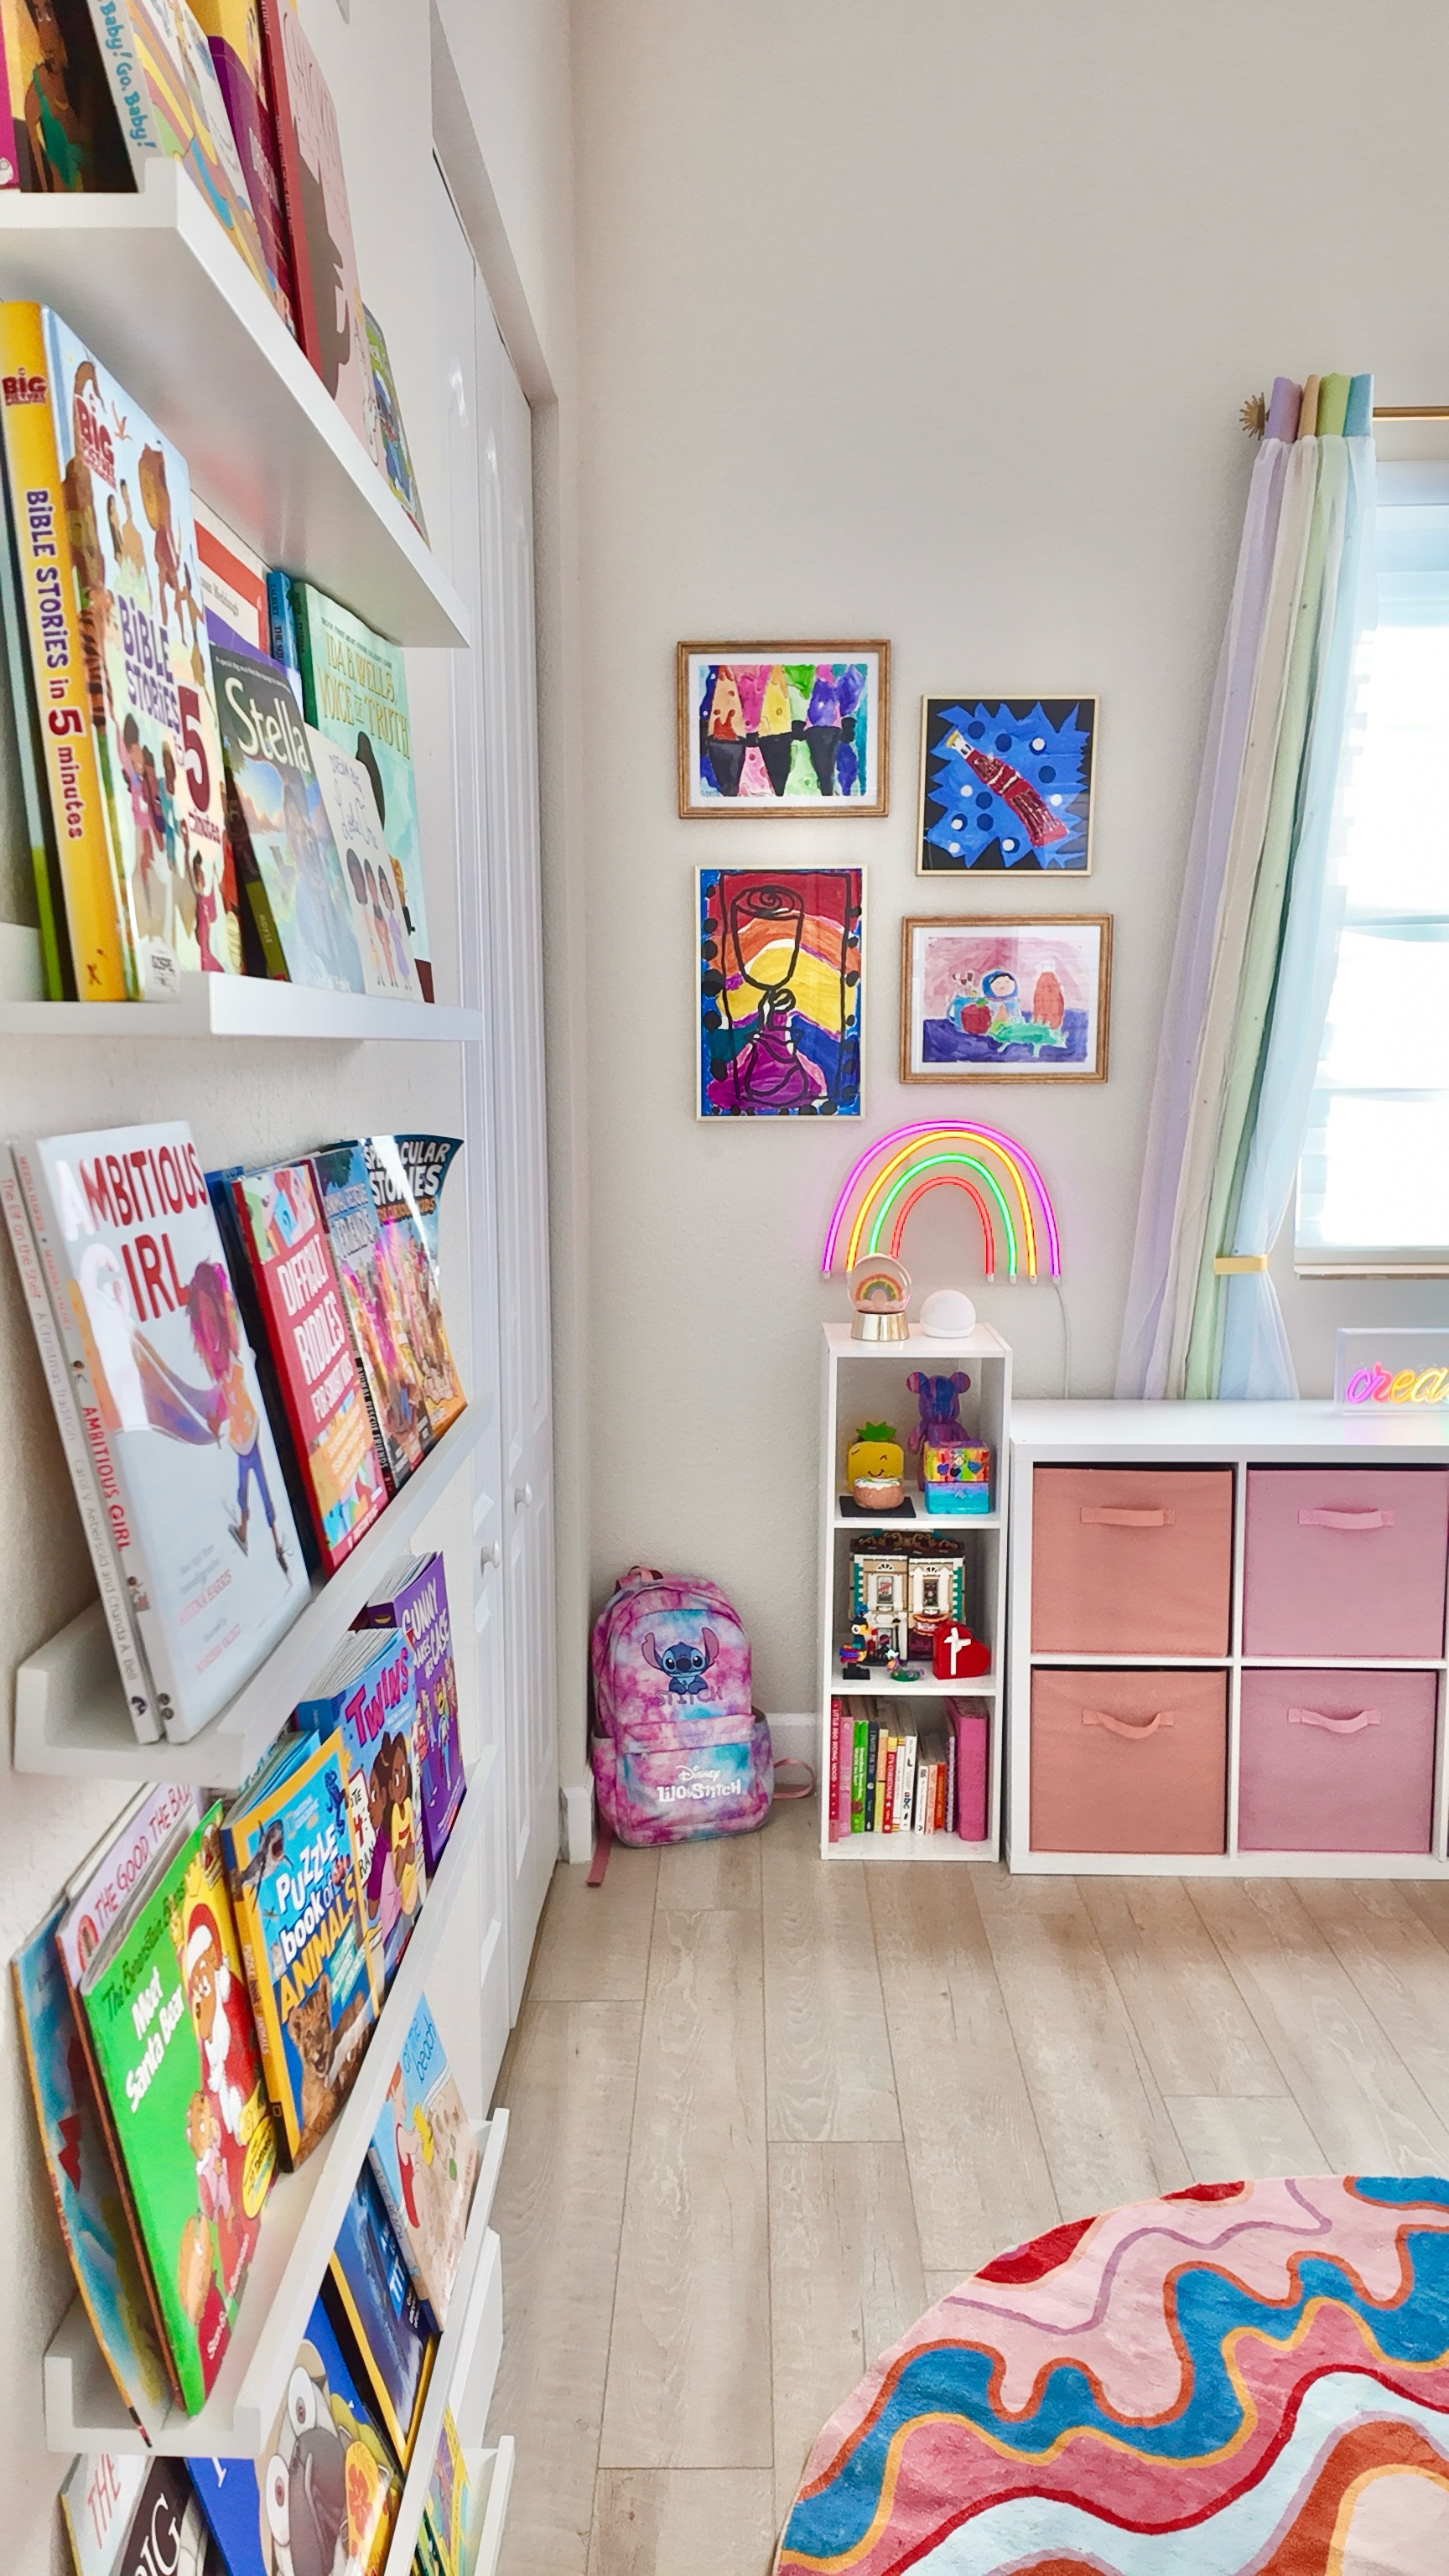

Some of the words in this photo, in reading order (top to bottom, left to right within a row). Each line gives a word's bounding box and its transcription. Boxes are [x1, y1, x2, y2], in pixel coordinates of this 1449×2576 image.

[100, 1, 133, 59] Baby!
[124, 91, 158, 148] Baby!
[275, 626, 283, 641] THE
[325, 631, 345, 676] IDA
[49, 678, 69, 699] in
[316, 663, 356, 726] VOICE
[364, 695, 411, 760] TRUTH
[48, 709, 83, 736] 5
[178, 684, 210, 813] 5
[224, 676, 312, 774] Stella
[58, 745, 85, 839] minutes
[363, 1140, 451, 1170] SPCULAR
[1, 1178, 15, 1202] The
[8, 1204, 22, 1219] Elf
[55, 1142, 208, 1242] AMBITIOUS
[14, 1224, 25, 1241] on
[19, 1244, 31, 1265] the
[25, 1270, 41, 1299] Shelf
[80, 1233, 191, 1322] GIRL
[276, 1233, 330, 1317] DIFFICULT
[40, 1324, 61, 1385] Christmas
[293, 1290, 345, 1386] RIDDLES
[1345, 1360, 1449, 1405] crea
[56, 1389, 76, 1441] Tradition
[356, 1367, 370, 1397] ANIMAL
[364, 1400, 379, 1433] RESCUE
[372, 1434, 389, 1468] FRIENDS
[74, 1459, 91, 1491] Carol
[82, 1406, 121, 1499] AMBITIOUS
[109, 1504, 132, 1552] GIRL
[86, 1507, 109, 1567] Aebersold
[101, 1571, 116, 1593] and
[108, 1595, 127, 1641] Chanda
[429, 1608, 450, 1666] CASE
[122, 1659, 138, 1681] Bell
[674, 1765, 722, 1783] Disney
[691, 1778, 742, 1800] Stitch
[903, 1791, 911, 1810] abc
[94, 1882, 119, 1929] THE
[116, 1836, 150, 1893] GOOD
[148, 1804, 172, 1844] THE
[275, 1822, 340, 1914] PUZZLE
[279, 1873, 358, 2025] ANIMALS
[280, 1889, 326, 1966] book
[131, 1965, 164, 2042] Meet
[126, 2032, 165, 2114] Santa
[158, 1982, 184, 2046] Bear
[387, 2204, 405, 2241] BEACH
[88, 2454, 122, 2550] THE
